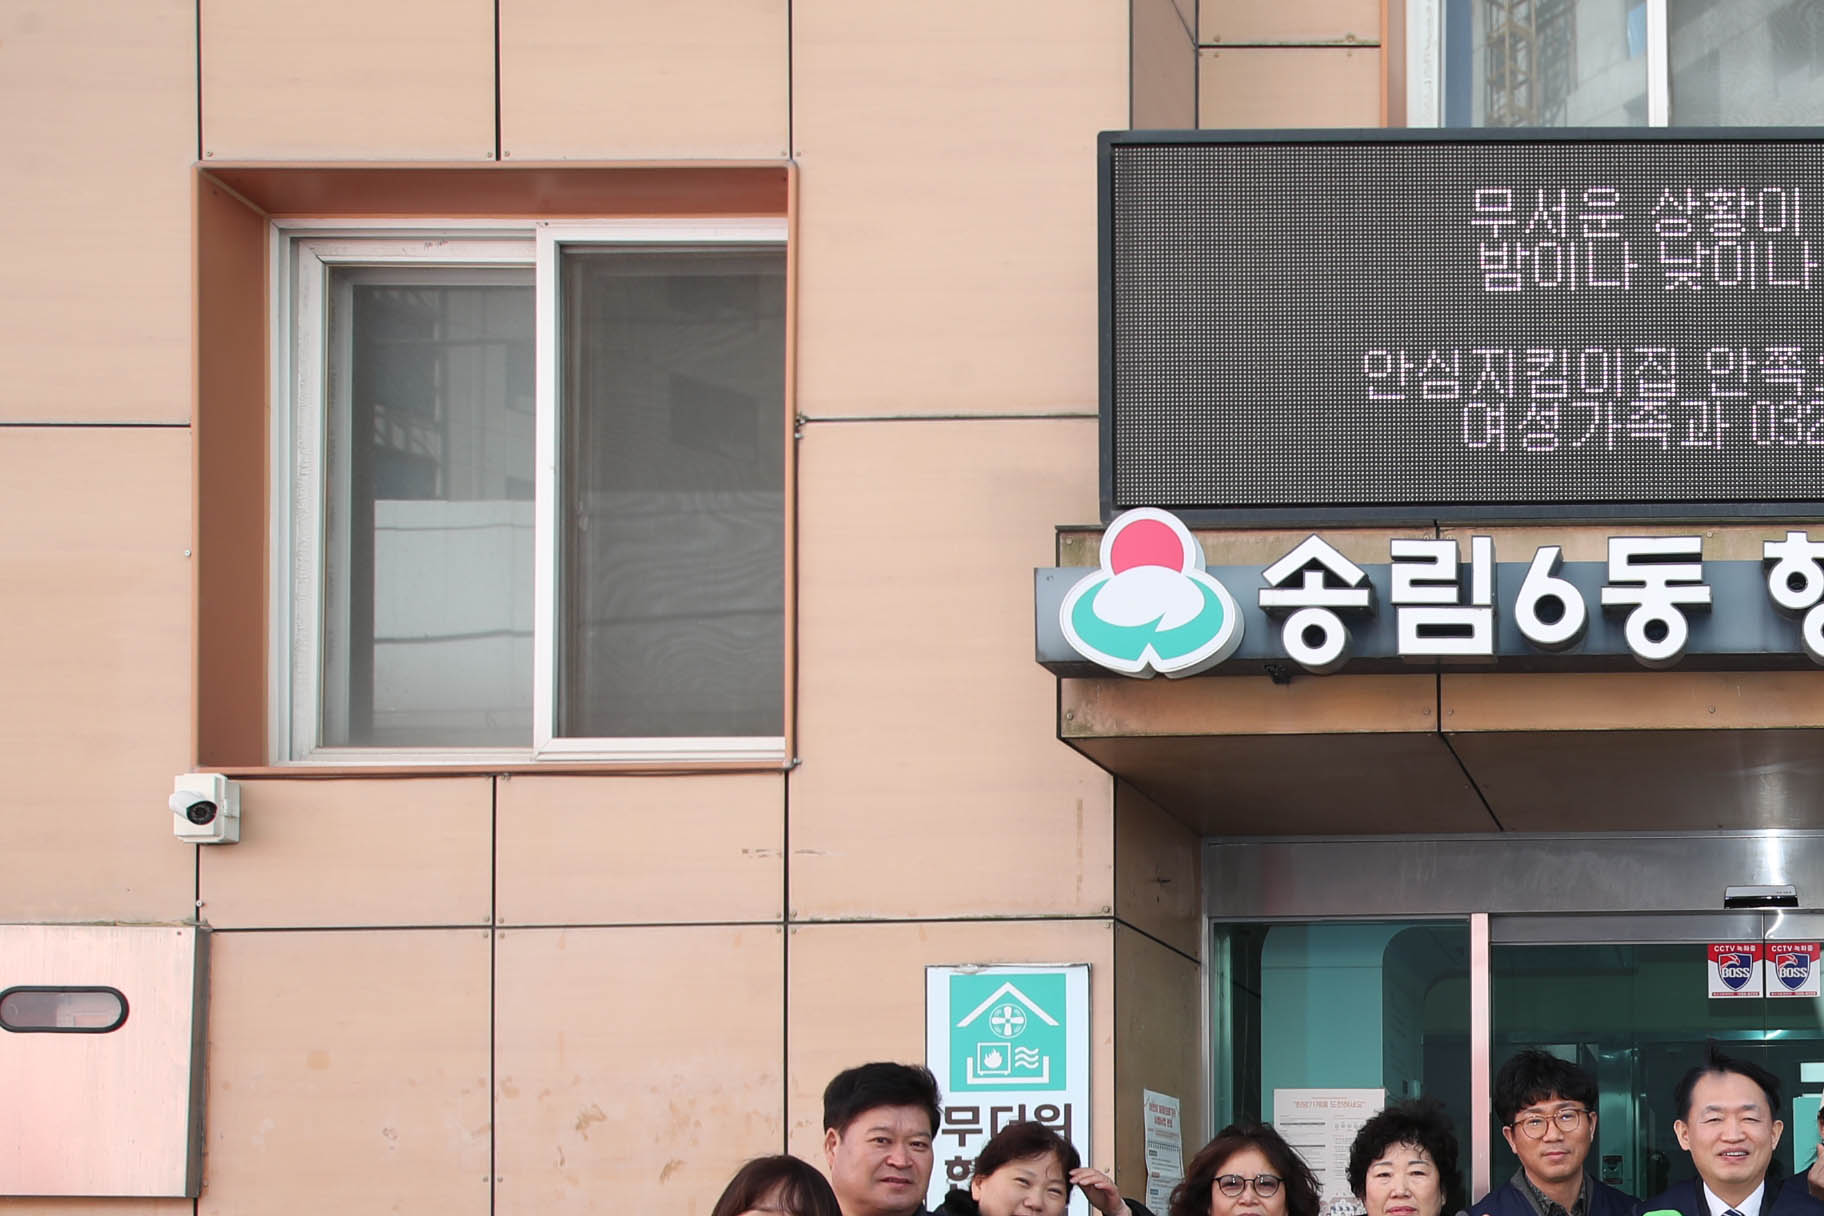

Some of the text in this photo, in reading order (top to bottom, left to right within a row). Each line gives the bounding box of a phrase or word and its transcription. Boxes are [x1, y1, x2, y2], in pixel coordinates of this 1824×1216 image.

[1471, 187, 1624, 239] 무서운
[1653, 186, 1804, 238] 상황이
[1479, 239, 1639, 292] 밤이나
[1660, 239, 1820, 291] 낮이나
[1361, 346, 1677, 401] 안심지킴이집
[1462, 399, 1731, 453] 여성가족과
[1256, 531, 1713, 670] 송림6동
[1722, 967, 1750, 978] BOSS
[1779, 967, 1807, 978] BOSS
